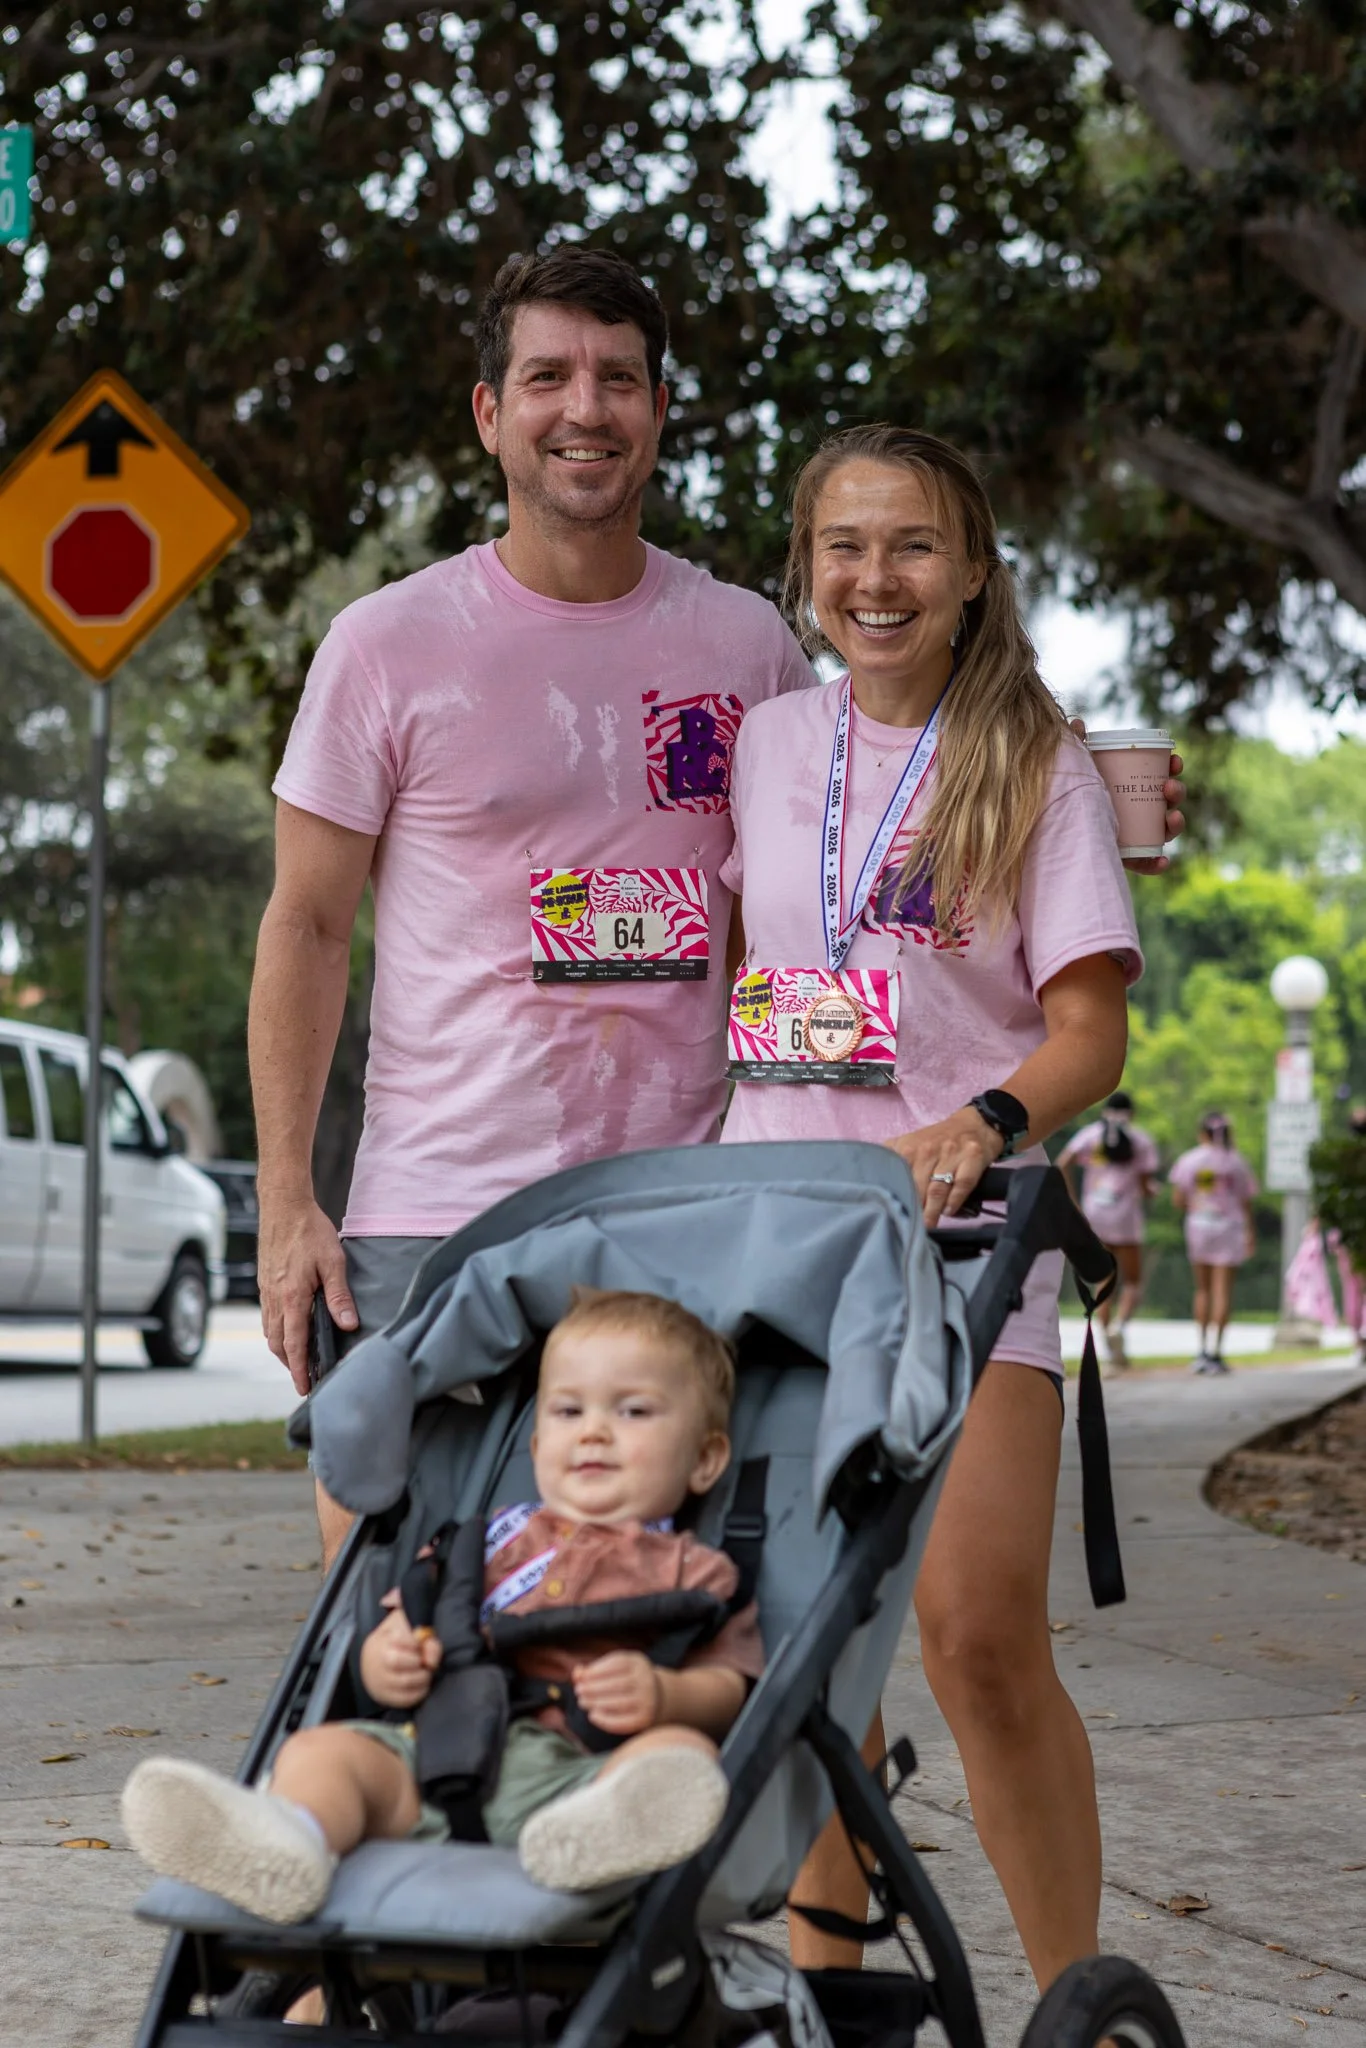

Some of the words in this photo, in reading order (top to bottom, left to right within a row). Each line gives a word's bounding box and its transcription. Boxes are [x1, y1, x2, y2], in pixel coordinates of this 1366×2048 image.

[836, 732, 845, 762] 2026
[831, 778, 842, 808] 2026
[1114, 785, 1138, 793] THE
[828, 825, 839, 855] 2026
[826, 874, 837, 906] 2026
[614, 917, 646, 950] 64
[791, 1018, 810, 1051] 6
